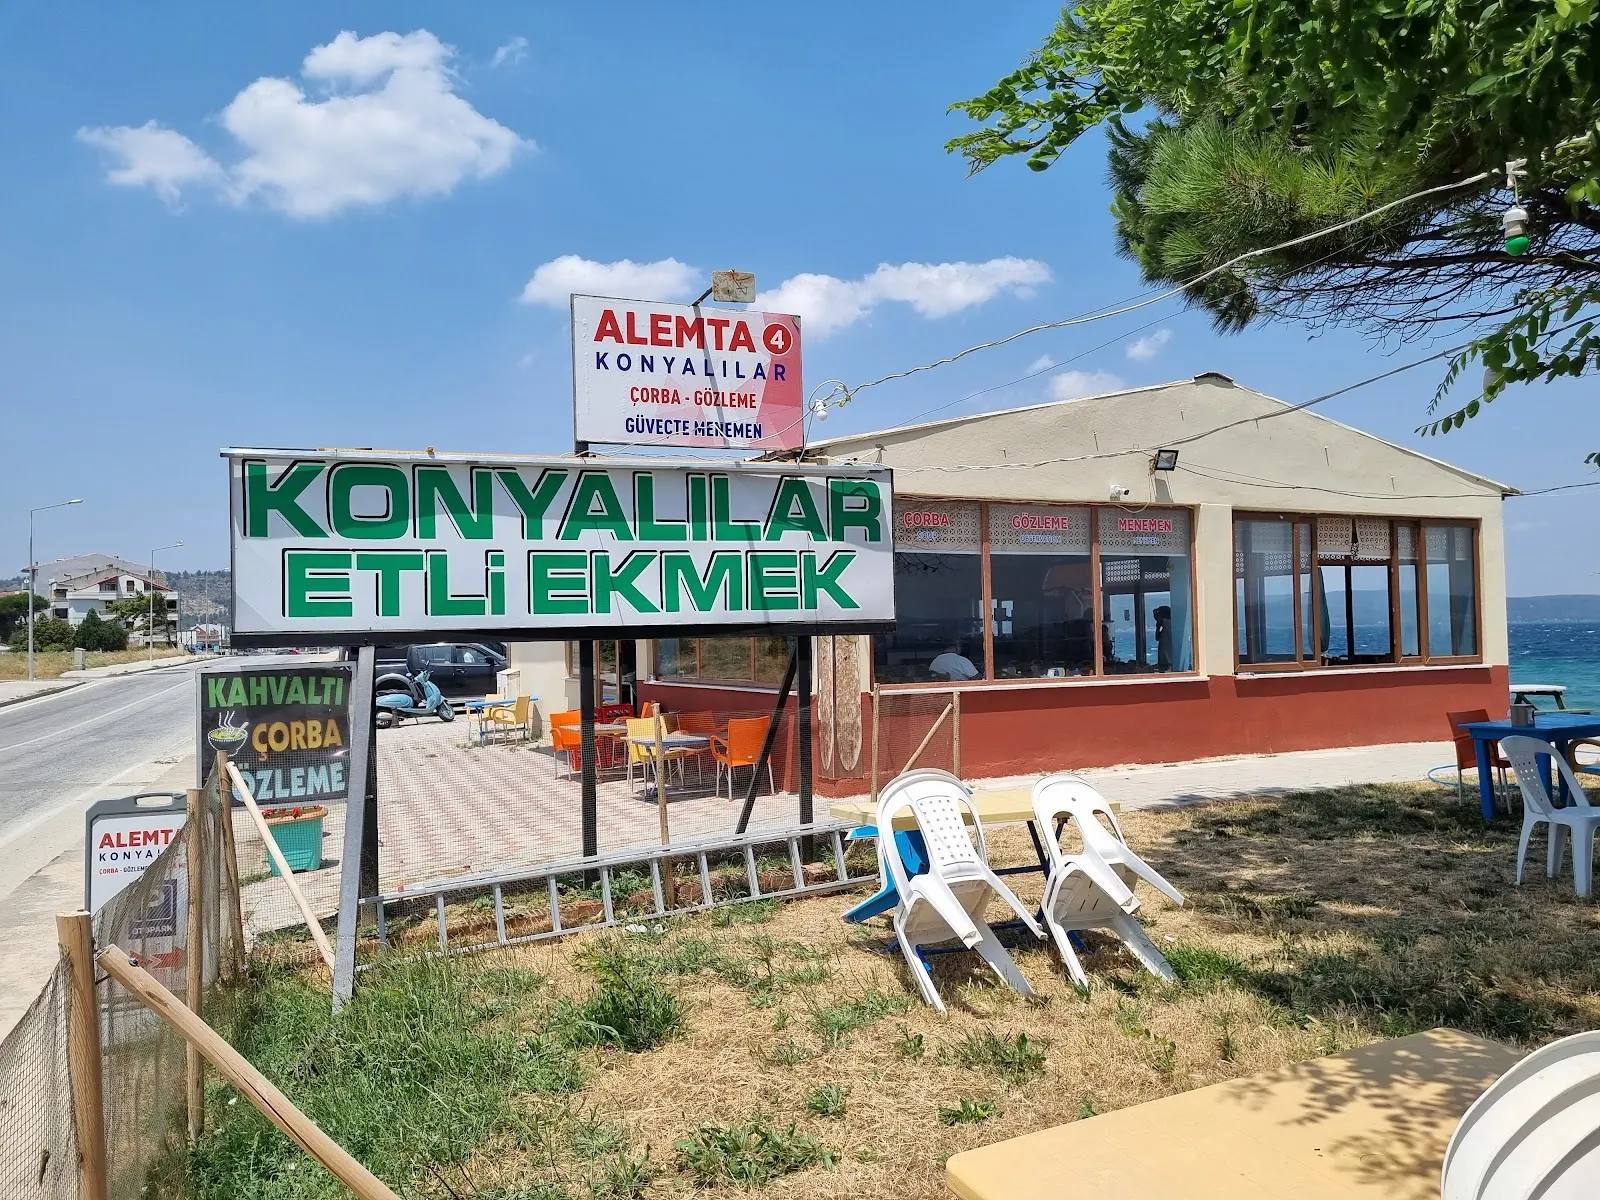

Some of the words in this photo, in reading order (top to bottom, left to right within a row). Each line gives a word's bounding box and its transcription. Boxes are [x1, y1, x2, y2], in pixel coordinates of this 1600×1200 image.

[594, 309, 756, 352] ALEMTA
[595, 351, 786, 381] KONYALILAR
[630, 386, 681, 406] ÇORBA
[694, 388, 756, 409] GÖZLEME
[694, 420, 762, 439] MENEMEN
[244, 460, 882, 542] KONYALILAR
[904, 512, 950, 528] ÇORBA
[1012, 513, 1069, 531] GÖZLEME
[1118, 518, 1173, 533] MENEMEN
[528, 549, 861, 613] EKMEK
[207, 676, 344, 708] KAHVALTI
[252, 719, 342, 762] ÇORBA
[231, 762, 346, 803] ÖZLEME
